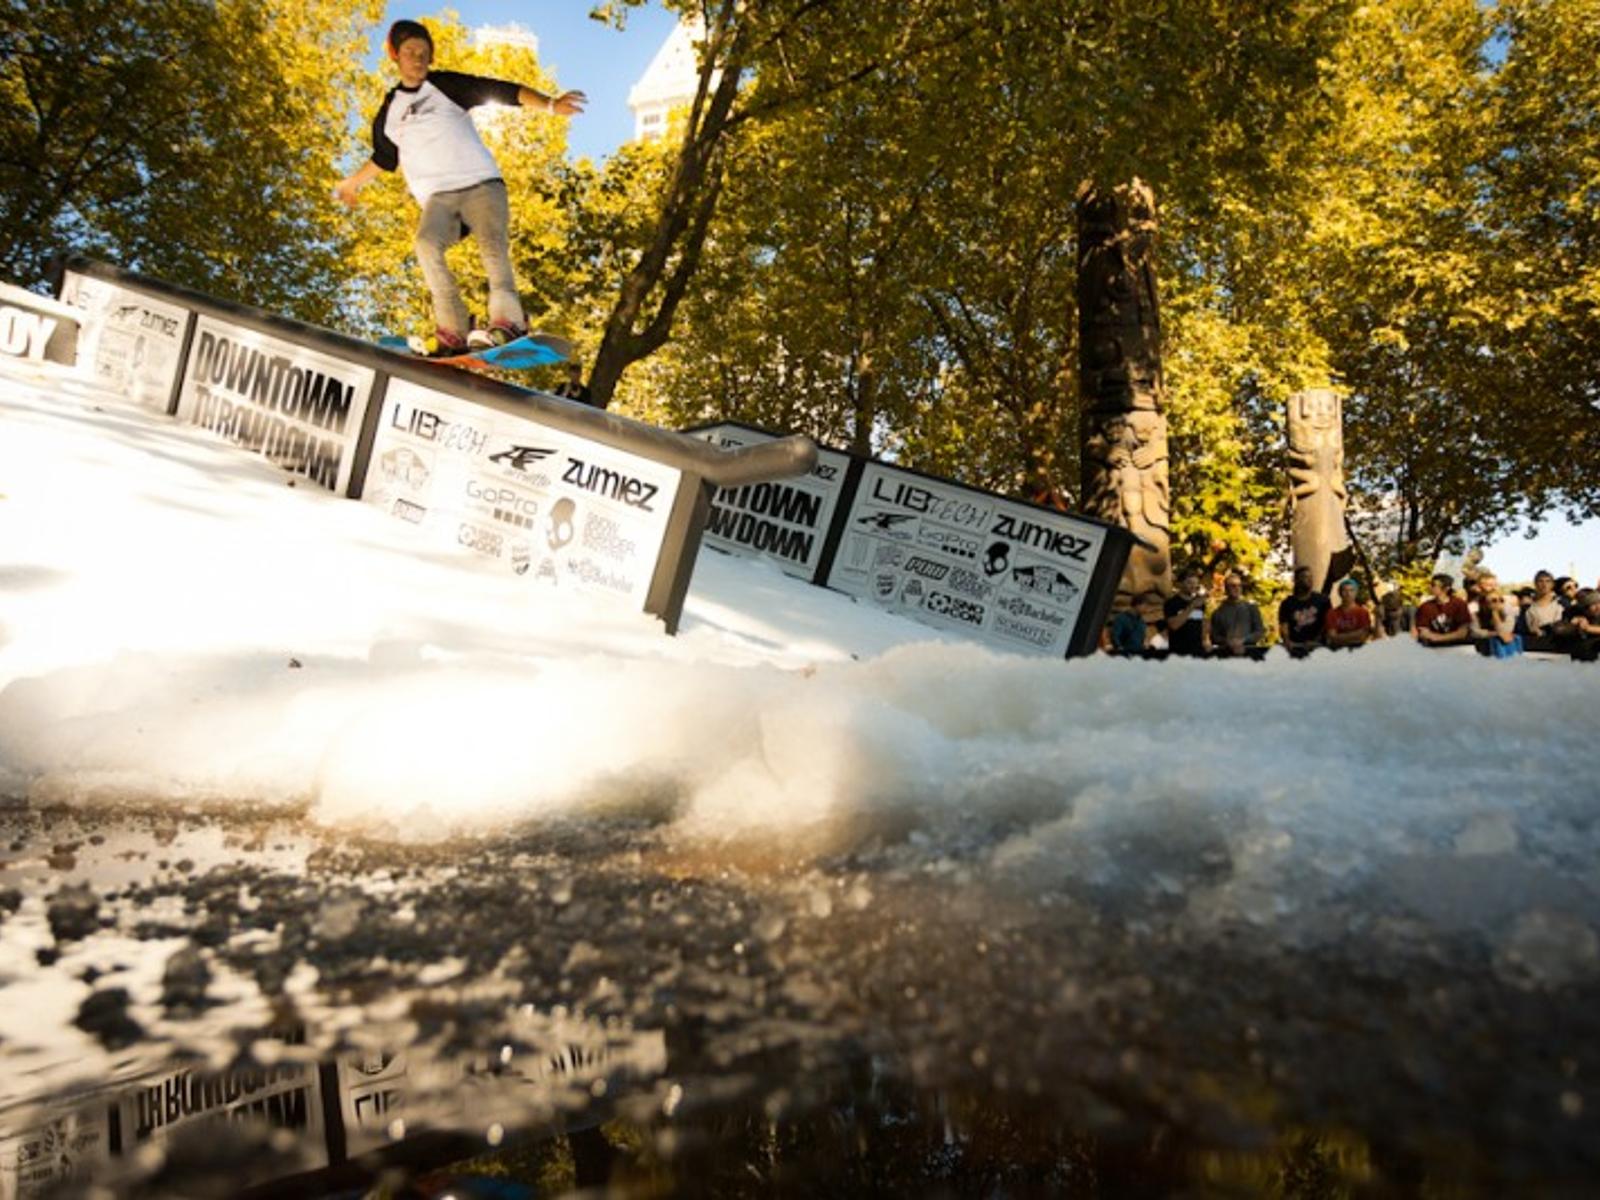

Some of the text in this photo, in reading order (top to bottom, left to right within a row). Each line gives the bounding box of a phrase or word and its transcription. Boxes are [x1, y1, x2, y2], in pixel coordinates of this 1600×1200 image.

[194, 330, 356, 435] DOWNTOWN
[191, 384, 346, 492] THROWDOWN
[466, 480, 538, 515] GoPro
